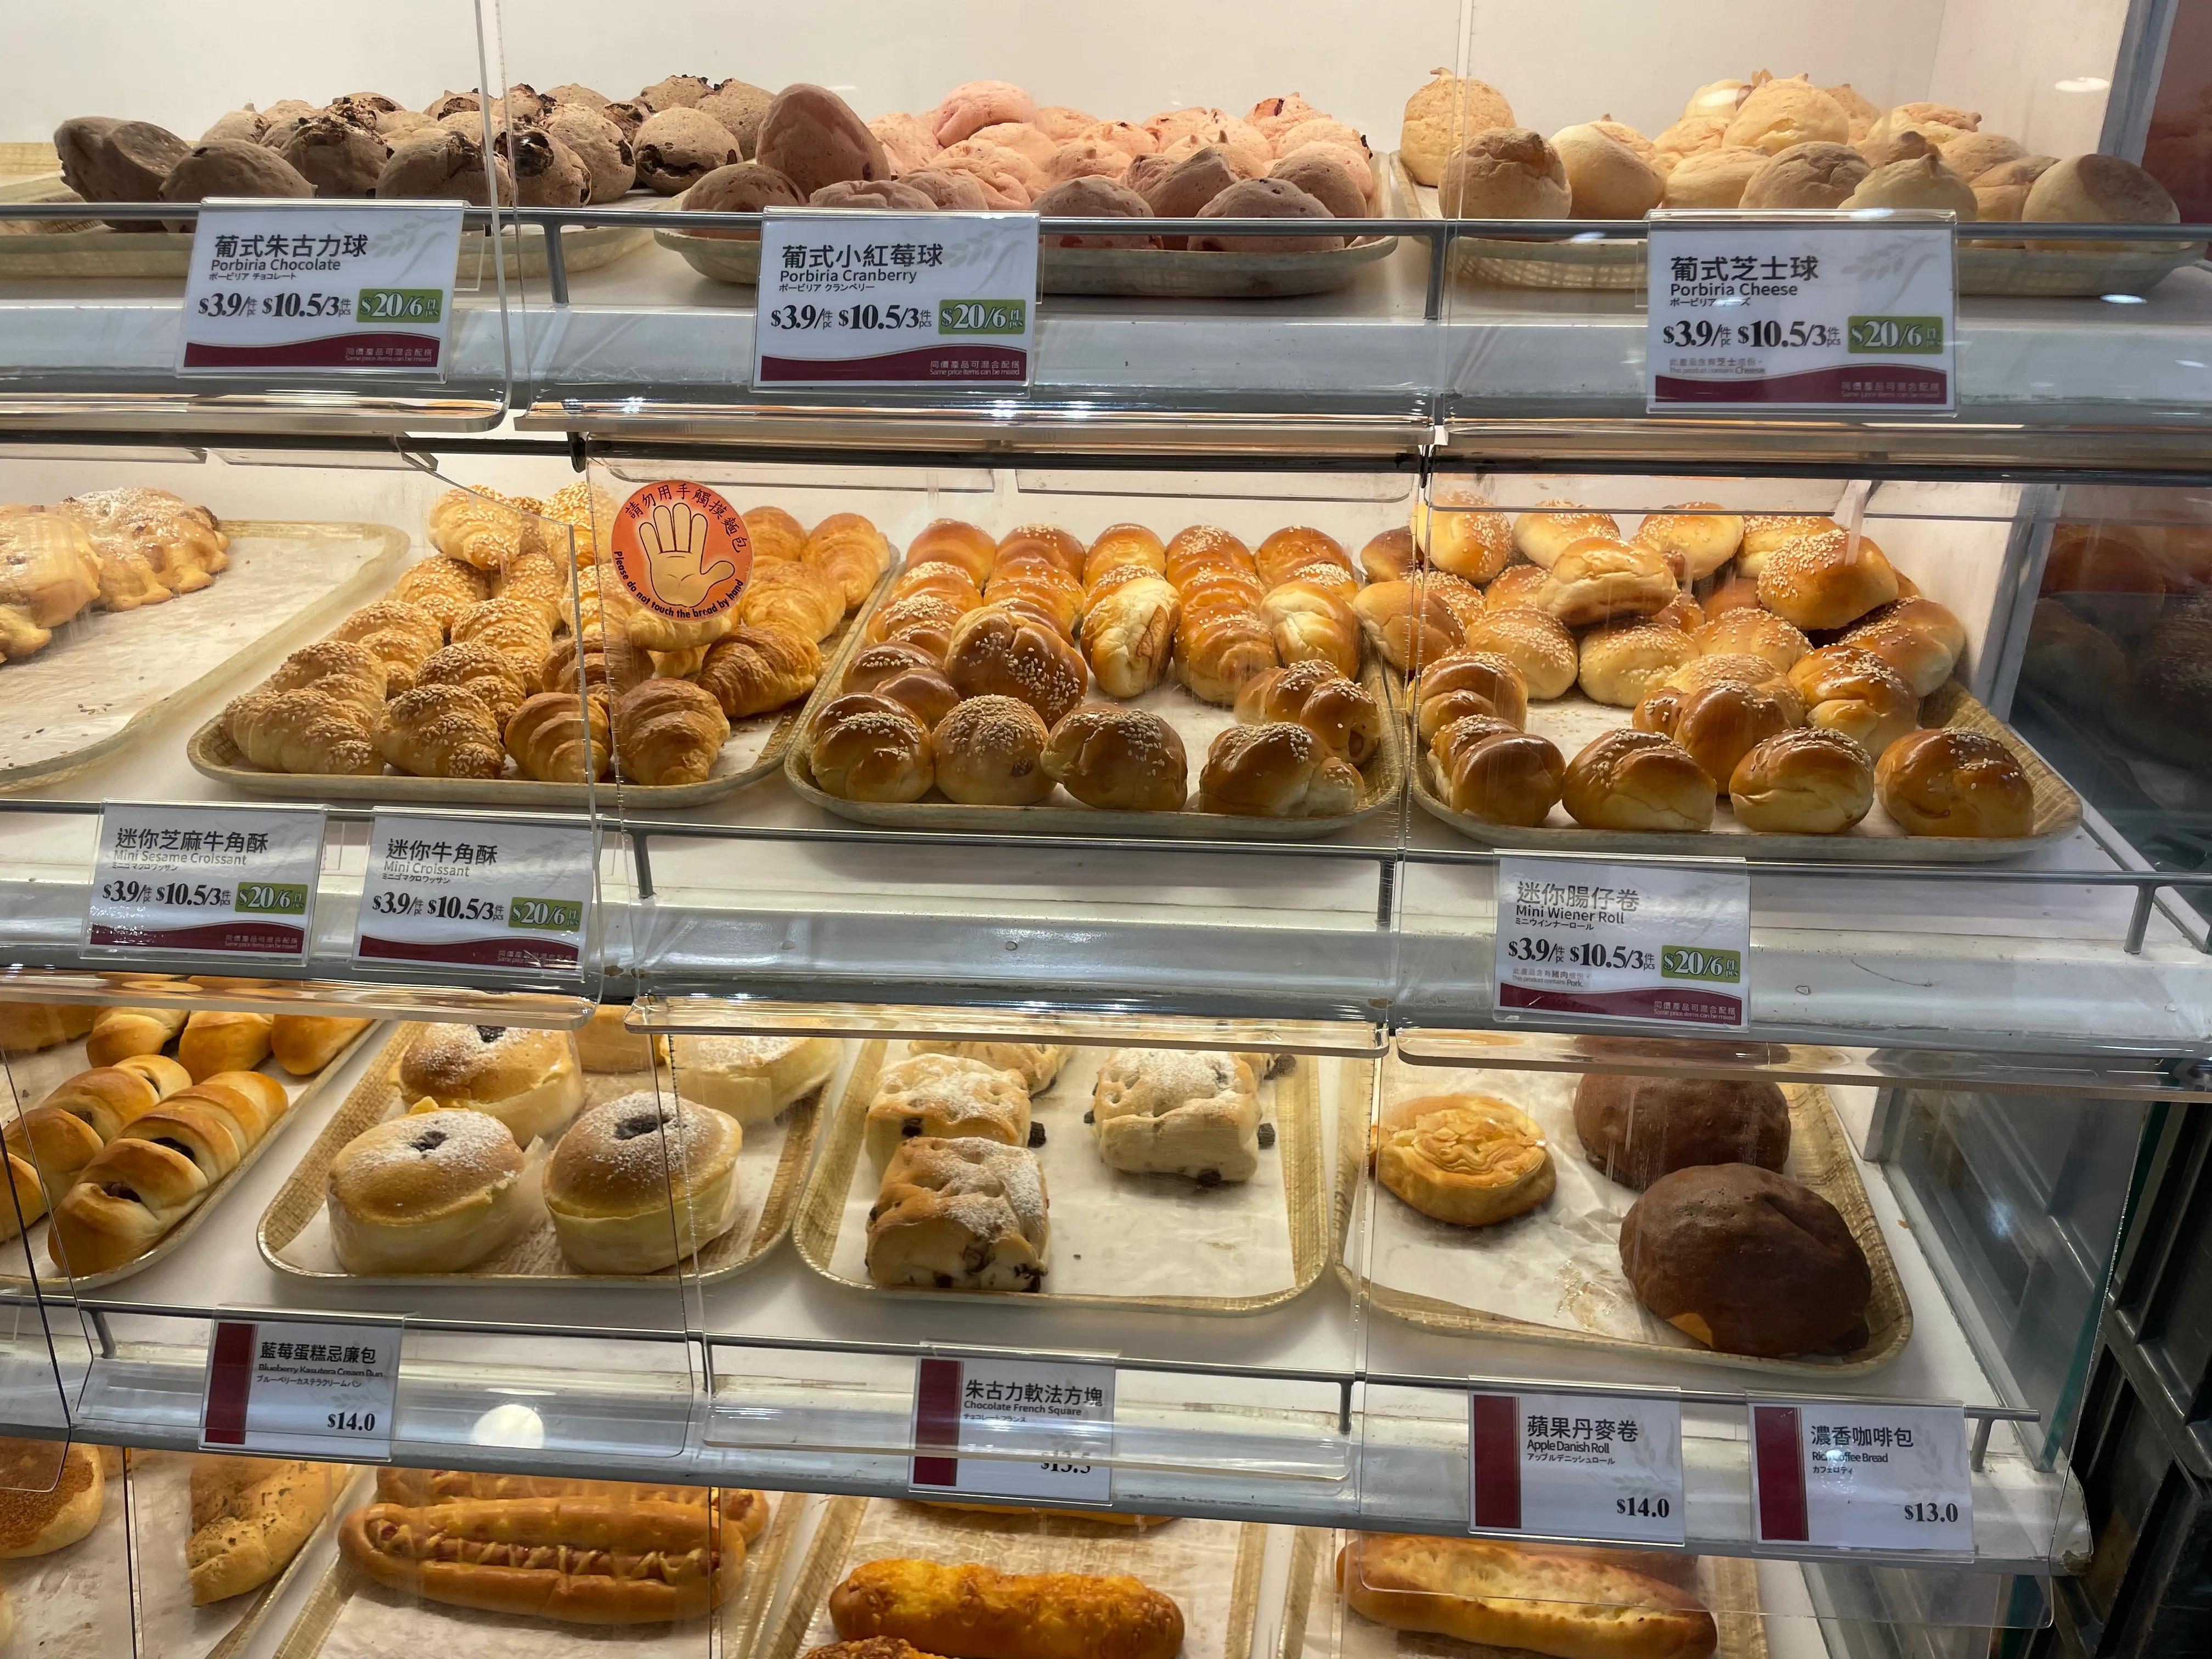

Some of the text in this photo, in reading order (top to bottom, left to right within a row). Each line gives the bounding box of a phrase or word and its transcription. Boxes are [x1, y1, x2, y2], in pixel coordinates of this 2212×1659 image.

[215, 234, 368, 257] 葡式朱古力球
[211, 259, 341, 270] Porbiria Chocolate
[782, 244, 943, 268] 葡式小紅莓球
[780, 269, 917, 284] Porbiria Cranberry
[1671, 256, 1819, 282] 葡式芝士球
[1671, 283, 1798, 296] Porbiria Cheese
[338, 308, 351, 317] pcs
[919, 320, 932, 329] pcs
[1826, 339, 1841, 348] pcs
[614, 551, 629, 580] Please
[627, 581, 637, 592] do
[636, 591, 651, 605] not
[651, 601, 674, 616] touch
[676, 610, 690, 618] the
[716, 598, 728, 609] by
[726, 579, 744, 600] hand
[115, 827, 268, 854] 迷你芝麻牛角酥
[114, 850, 247, 865] Mini Sesame Croissant
[386, 838, 498, 866] 迷你牛角酥
[384, 861, 470, 877] Mini Croissant
[1517, 881, 1639, 912] 迷你腸仔卷
[1516, 905, 1624, 924] Mini Wiener Roll
[1643, 963, 1655, 971] pcs
[260, 1342, 376, 1364] 藍莓蛋糕忌廉包
[258, 1364, 298, 1374] Blueberry
[337, 1368, 364, 1376] Cream
[966, 1379, 1103, 1407] 朱古力軟法方塊
[964, 1401, 1082, 1416] Chocolate French Square
[328, 1412, 375, 1431] $14.0
[1527, 1415, 1638, 1442] 蘋果丹麥卷
[1811, 1426, 1914, 1447] 濃香咖啡包
[1527, 1440, 1610, 1453] Apple Danish Roll
[1863, 1453, 1888, 1462] Bread
[1617, 1497, 1669, 1518] $14.0
[1905, 1503, 1958, 1522] $13.0
